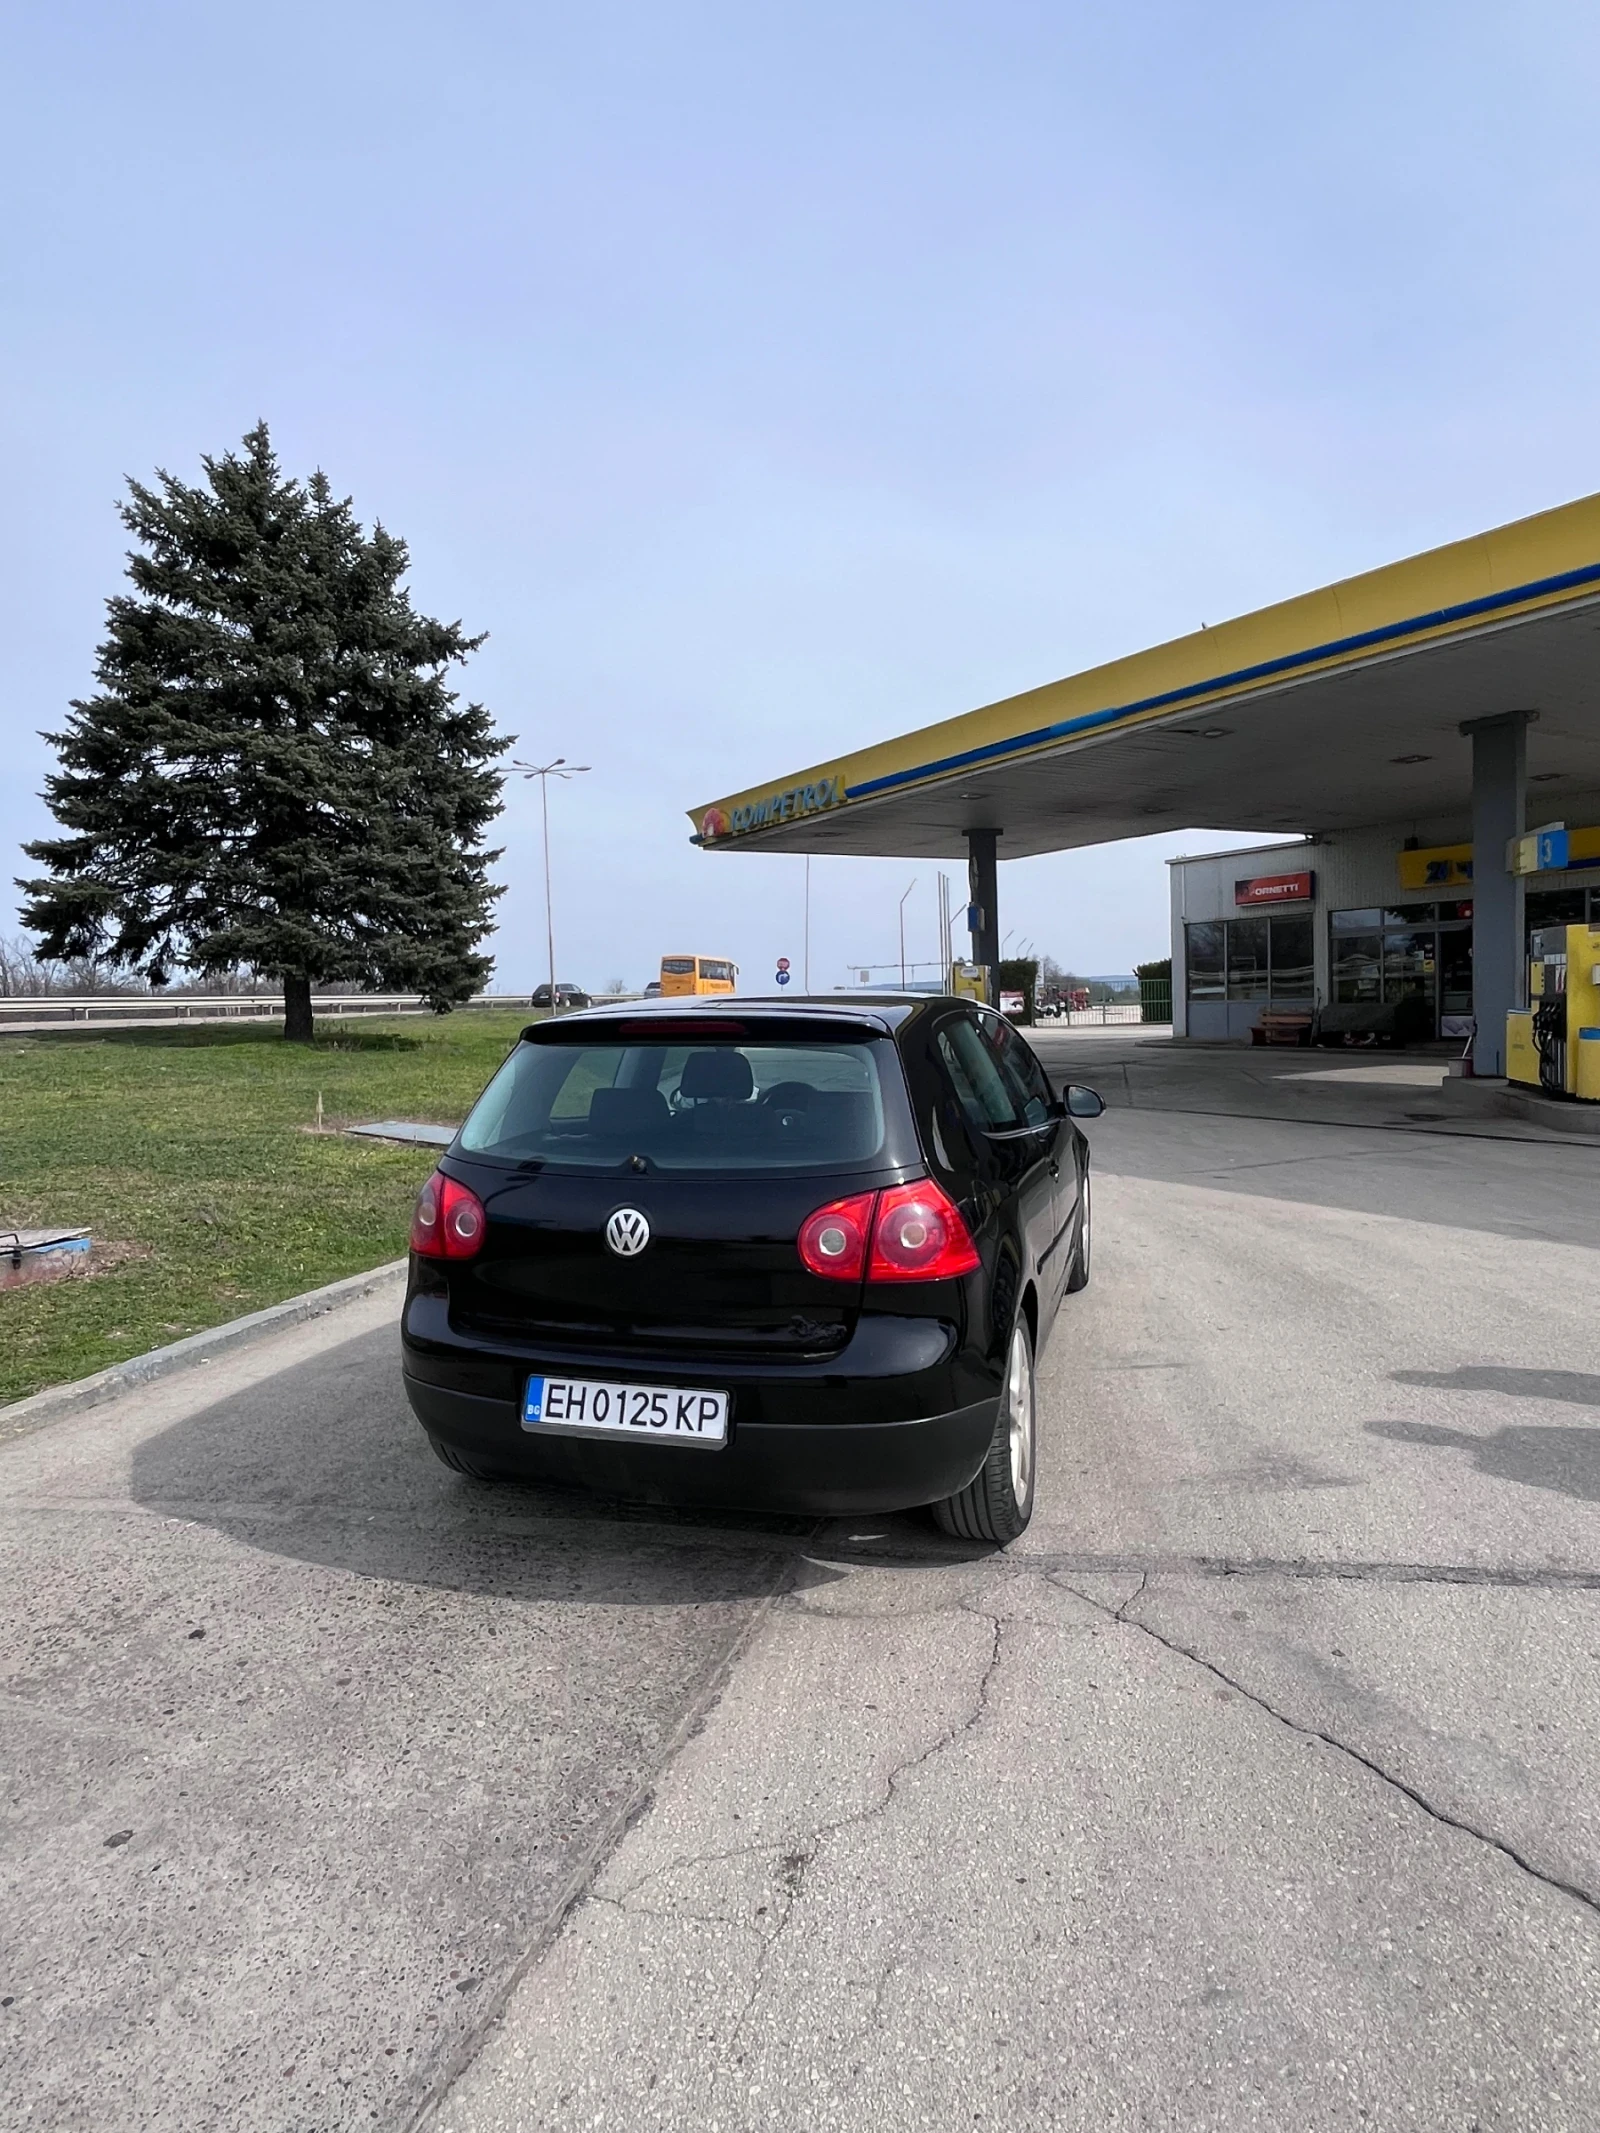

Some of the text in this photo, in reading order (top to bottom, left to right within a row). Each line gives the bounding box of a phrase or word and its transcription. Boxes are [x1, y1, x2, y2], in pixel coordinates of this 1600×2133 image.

[1543, 838, 1553, 863] 3
[608, 1210, 649, 1255] VW
[527, 1404, 540, 1415] BG
